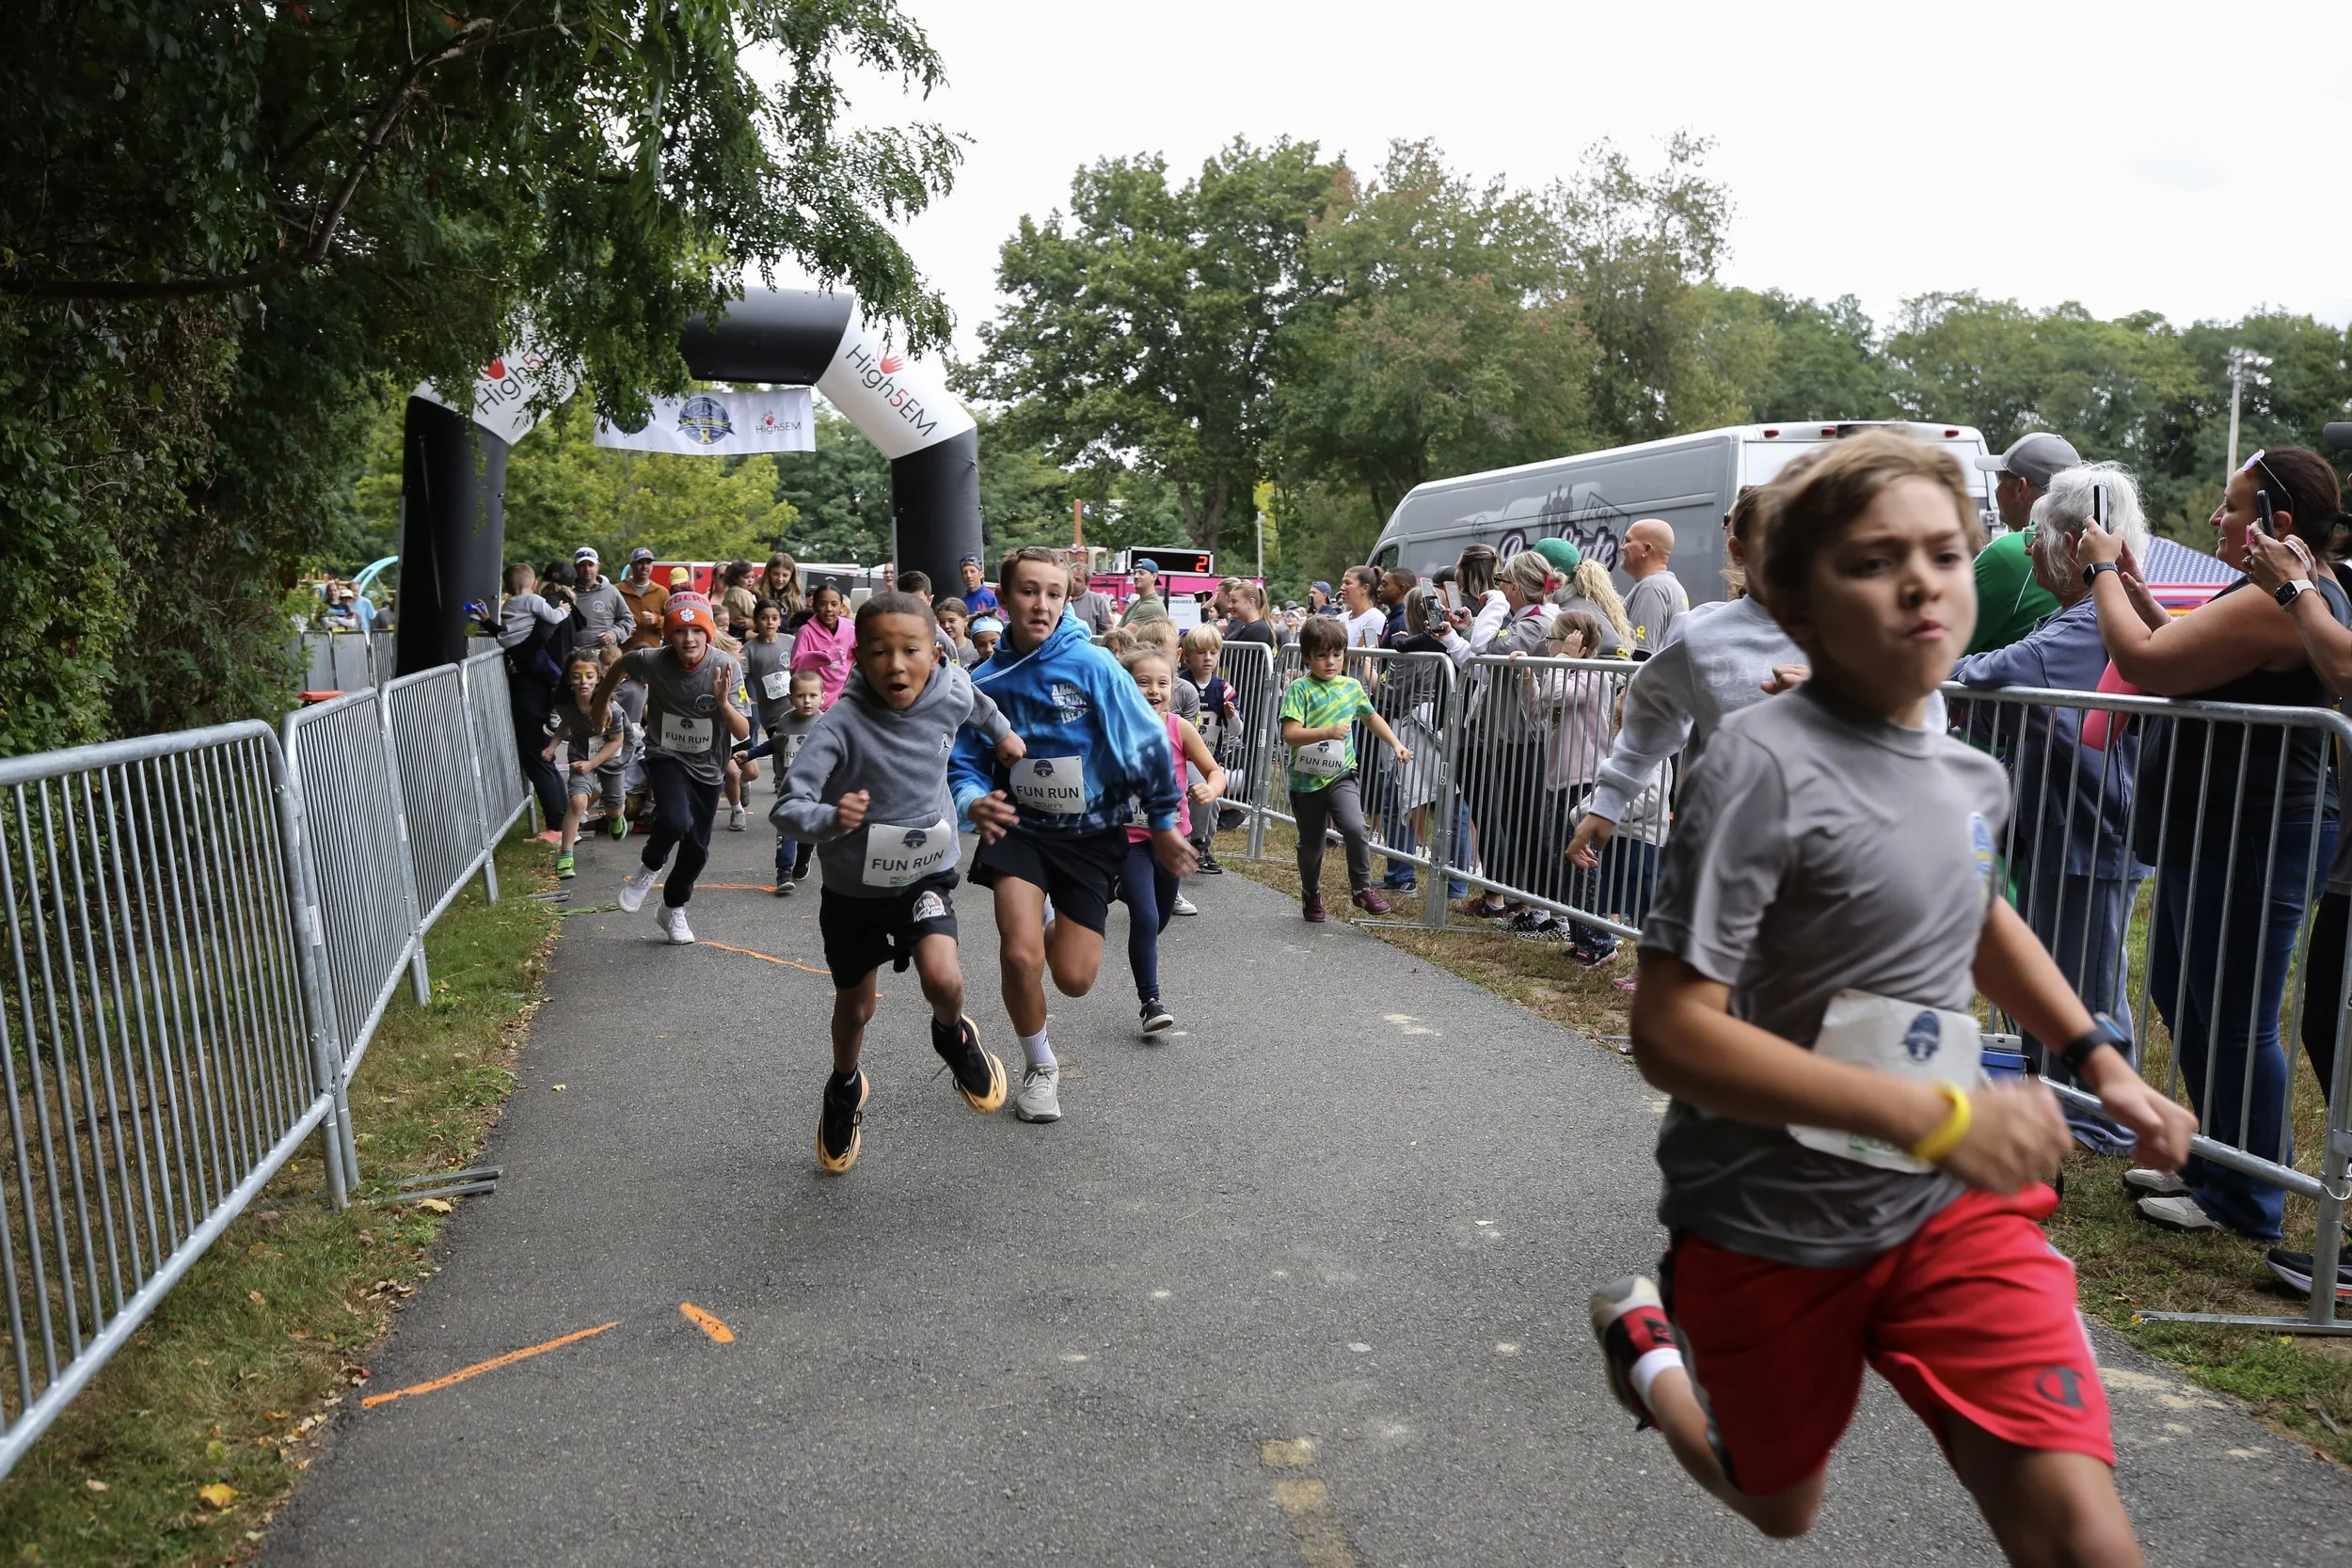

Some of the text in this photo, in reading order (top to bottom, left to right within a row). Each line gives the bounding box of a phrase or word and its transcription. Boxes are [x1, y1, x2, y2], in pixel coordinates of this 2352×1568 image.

[845, 343, 938, 437] High5EM
[755, 421, 802, 436] High5EM
[1195, 555, 1209, 572] 2
[768, 685, 781, 693] FUN
[665, 732, 709, 744] FUN RUN
[1299, 756, 1343, 768] FUN RUN
[1016, 784, 1079, 799] FUN RUN
[1133, 805, 1148, 815] UN
[871, 849, 945, 872] FUN RUN
